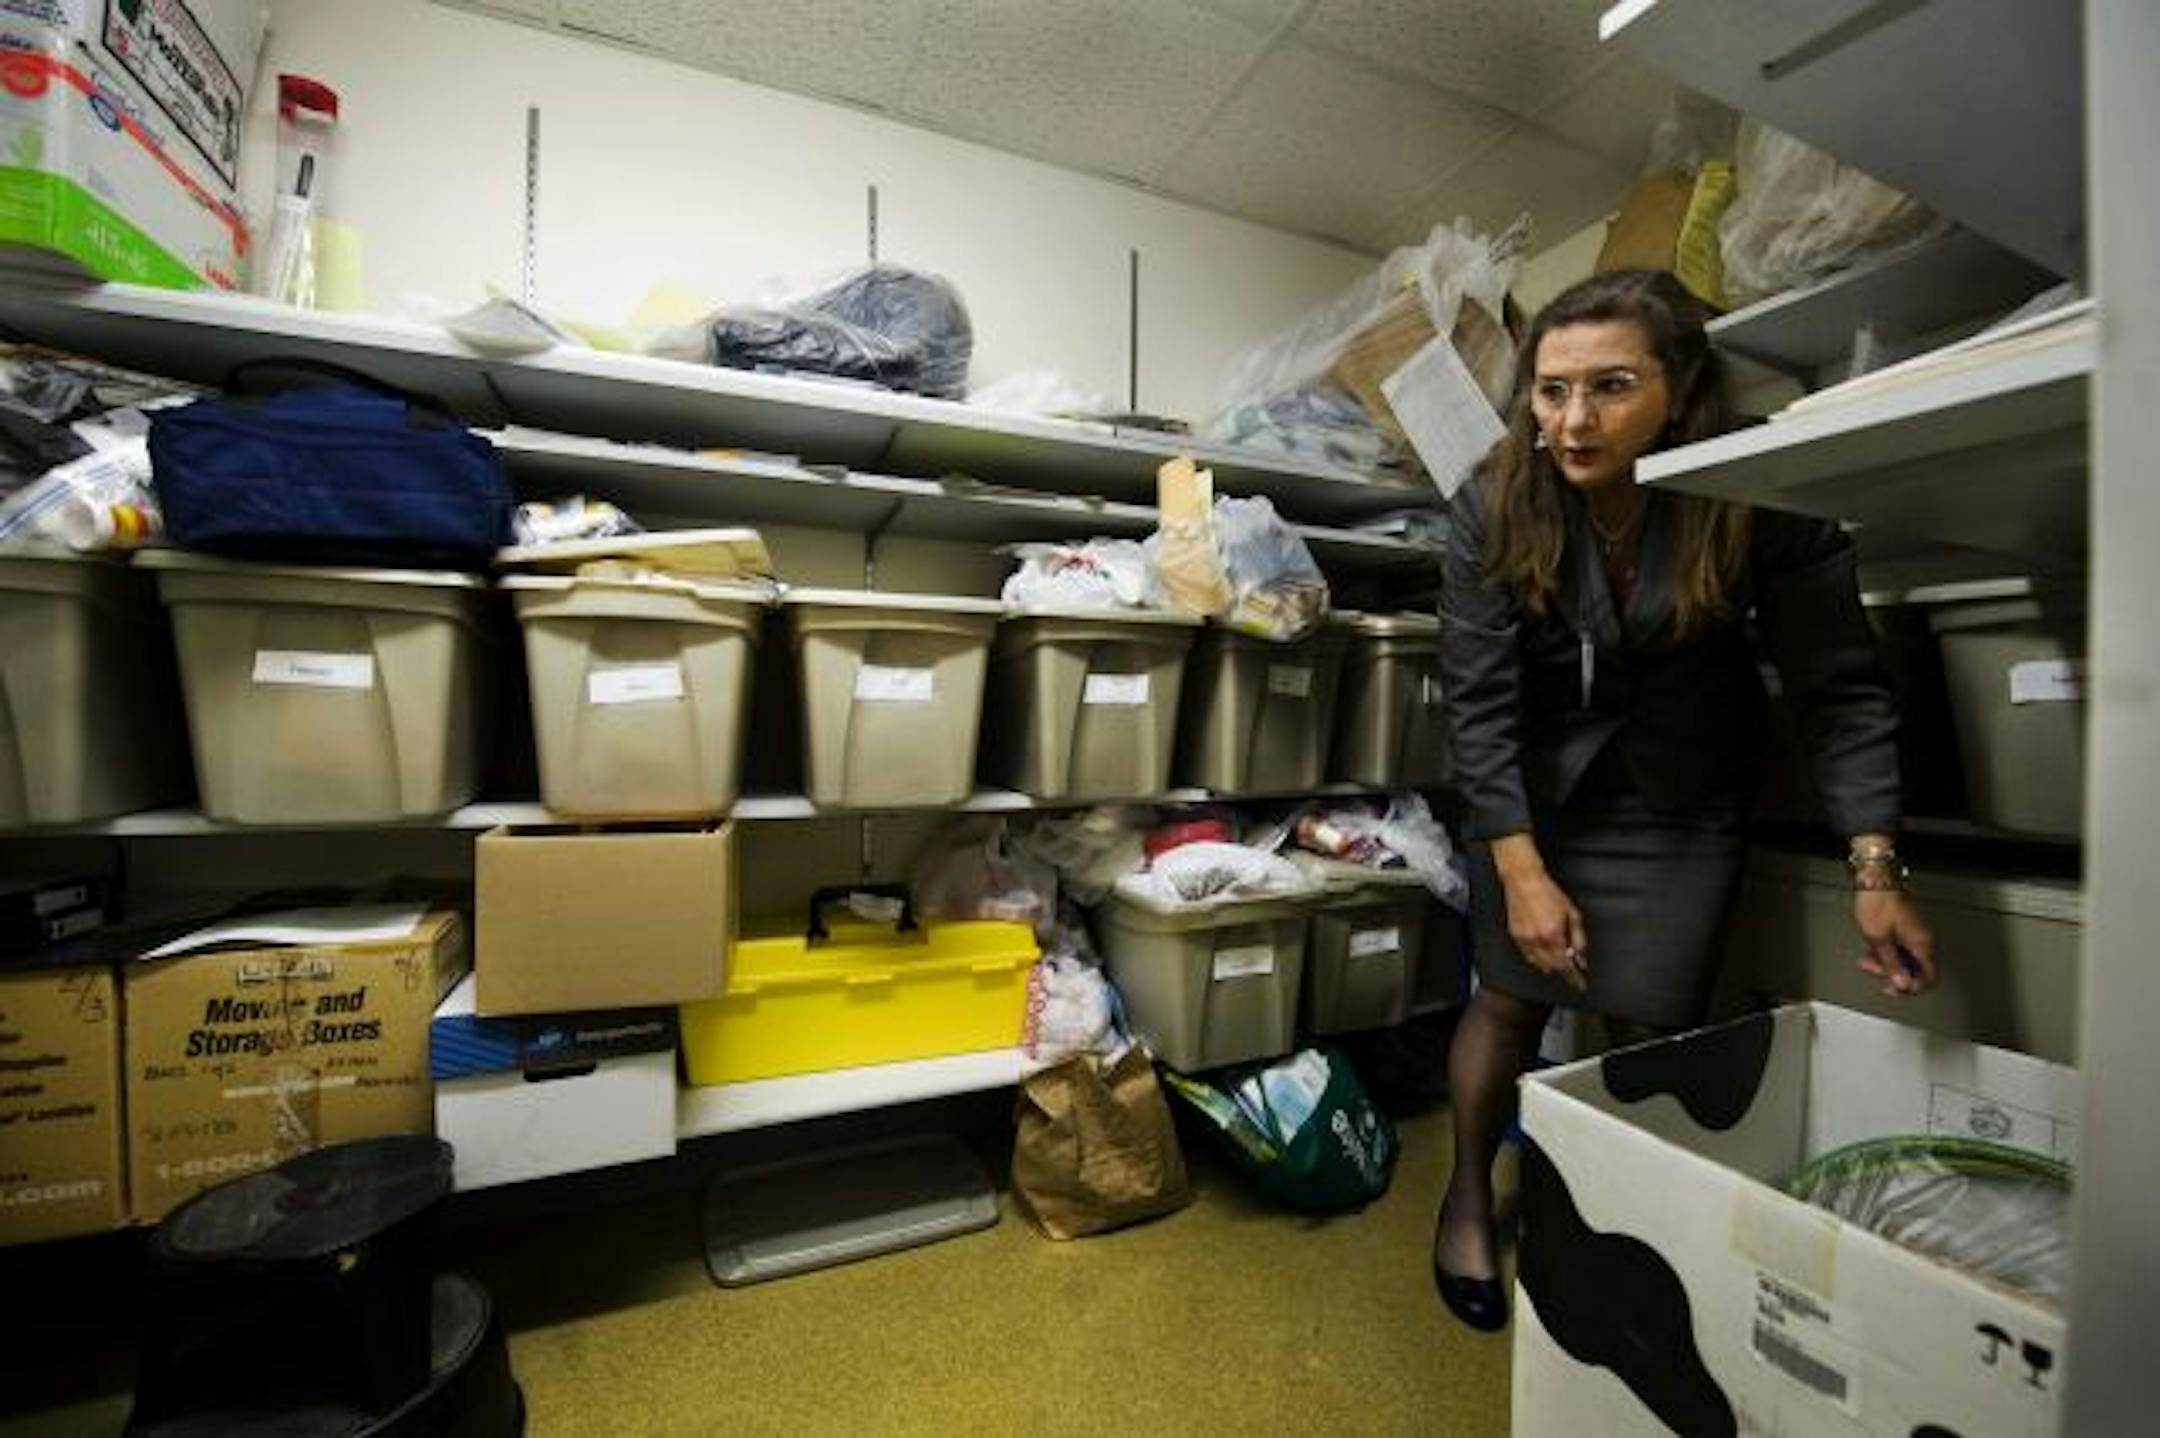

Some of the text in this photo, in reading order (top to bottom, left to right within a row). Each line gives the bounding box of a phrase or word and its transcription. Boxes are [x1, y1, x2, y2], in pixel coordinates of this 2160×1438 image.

[313, 985, 367, 1016] and
[185, 1019, 382, 1058] Storag Boxes
